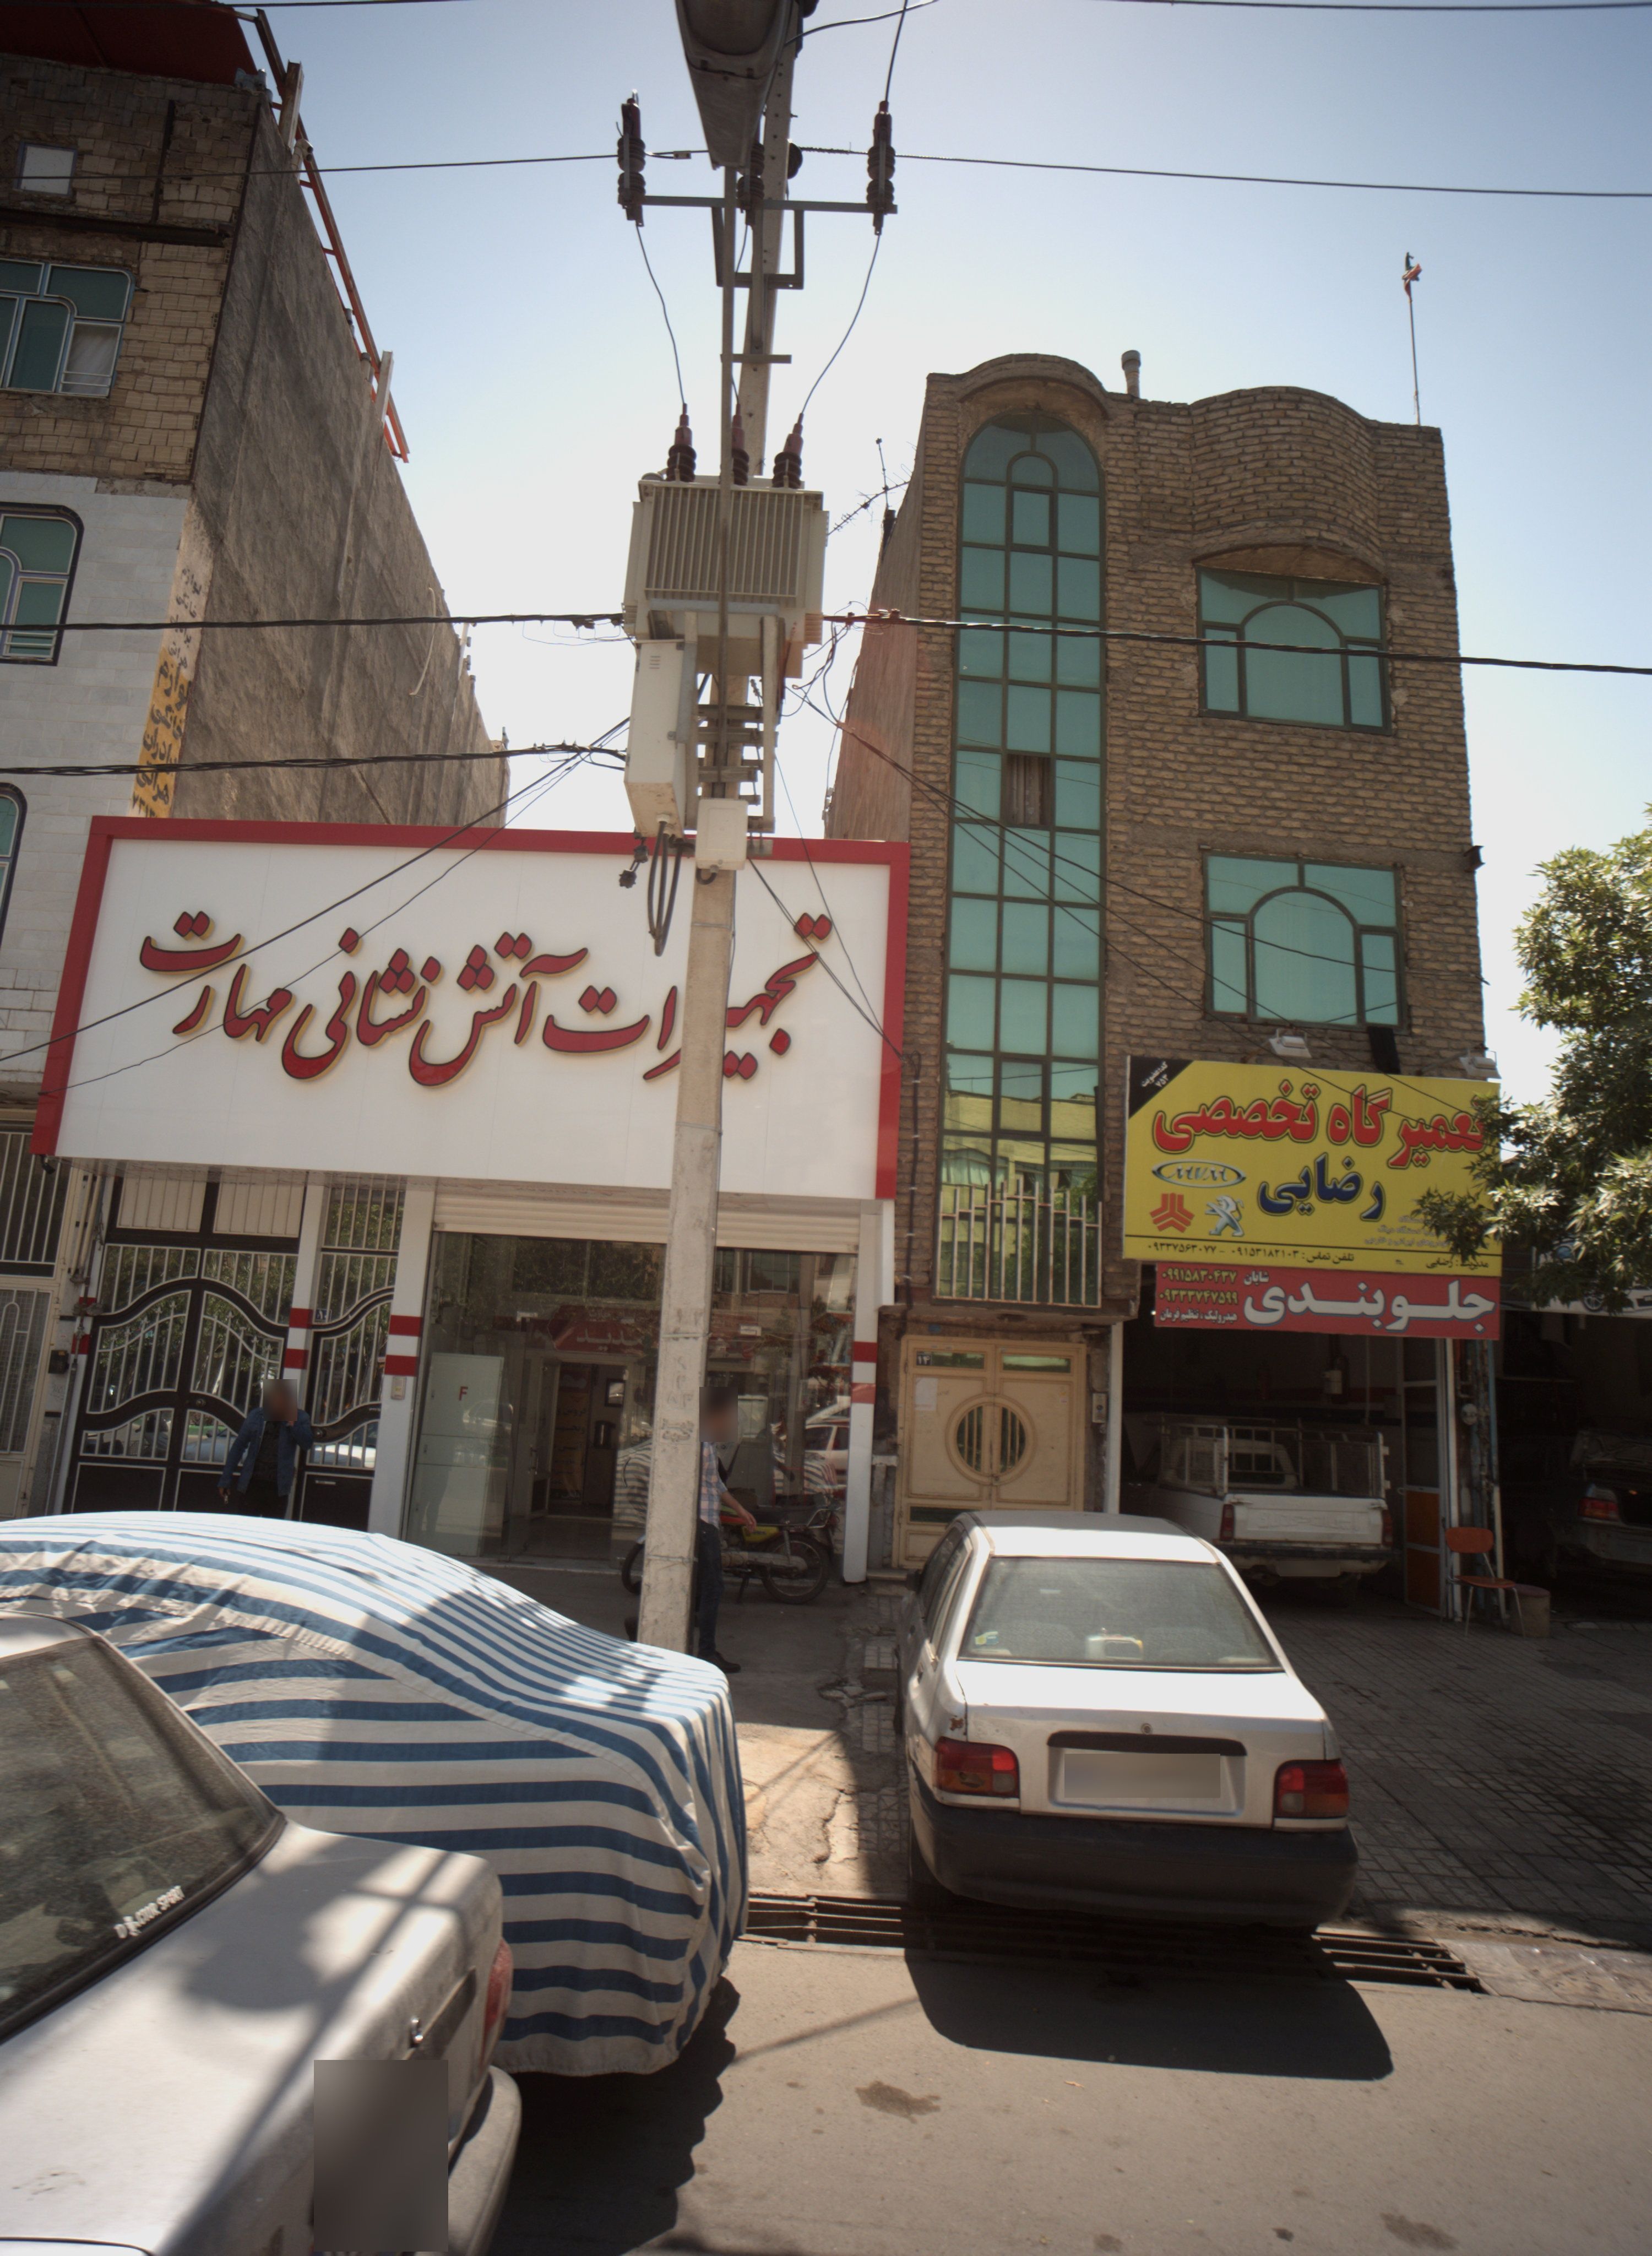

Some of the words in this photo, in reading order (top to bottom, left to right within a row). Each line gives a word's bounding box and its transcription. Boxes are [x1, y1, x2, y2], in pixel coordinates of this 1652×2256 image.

[139, 911, 295, 1044] مهارت
[281, 927, 442, 1081] نشانی
[409, 931, 588, 1088] آتش
[1152, 1079, 1319, 1153] تخصصی
[1166, 1164, 1228, 1182] MVM
[1258, 1153, 1385, 1221] رضایی
[1243, 1270, 1270, 1286] شایان
[1332, 1252, 1355, 1265] تلفن
[1160, 1307, 1180, 1322] فرمان
[1242, 1279, 1496, 1334] جلوبندی
